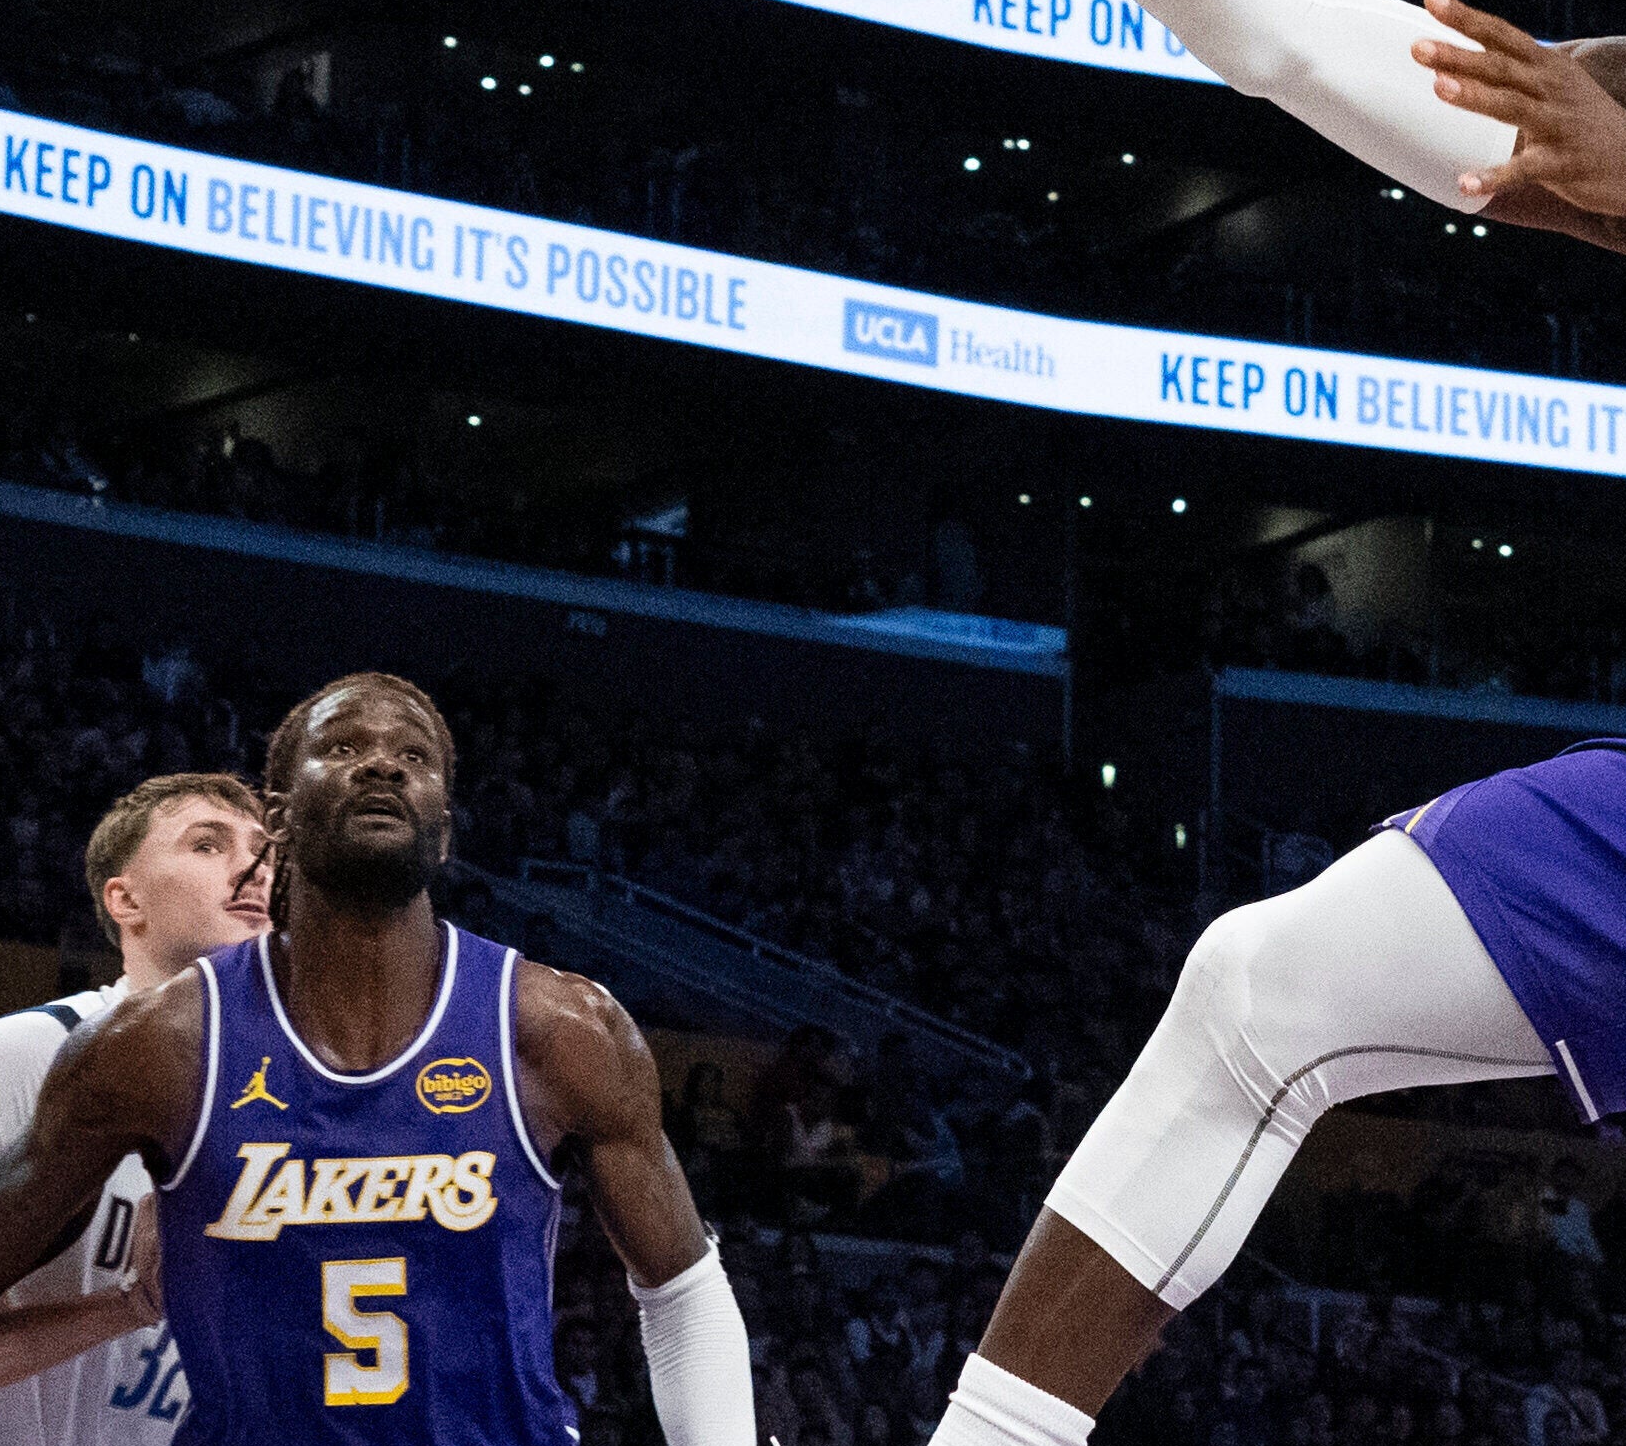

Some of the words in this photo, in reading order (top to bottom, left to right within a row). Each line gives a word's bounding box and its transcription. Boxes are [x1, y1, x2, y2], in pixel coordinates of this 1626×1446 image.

[2, 133, 113, 209] KEEP
[129, 162, 189, 228] ON
[207, 178, 434, 273] BELIEVING
[453, 225, 529, 291] IT'S
[546, 243, 748, 332] POSSIBLE
[855, 311, 929, 354] UCLA
[949, 329, 1056, 378] Health
[1160, 352, 1267, 412] KEEP
[1283, 366, 1339, 422] ON
[1357, 376, 1570, 449] BELIEVING
[424, 1071, 487, 1096] bibigo
[205, 1142, 498, 1242] LAKERS
[322, 1257, 409, 1407] 5
